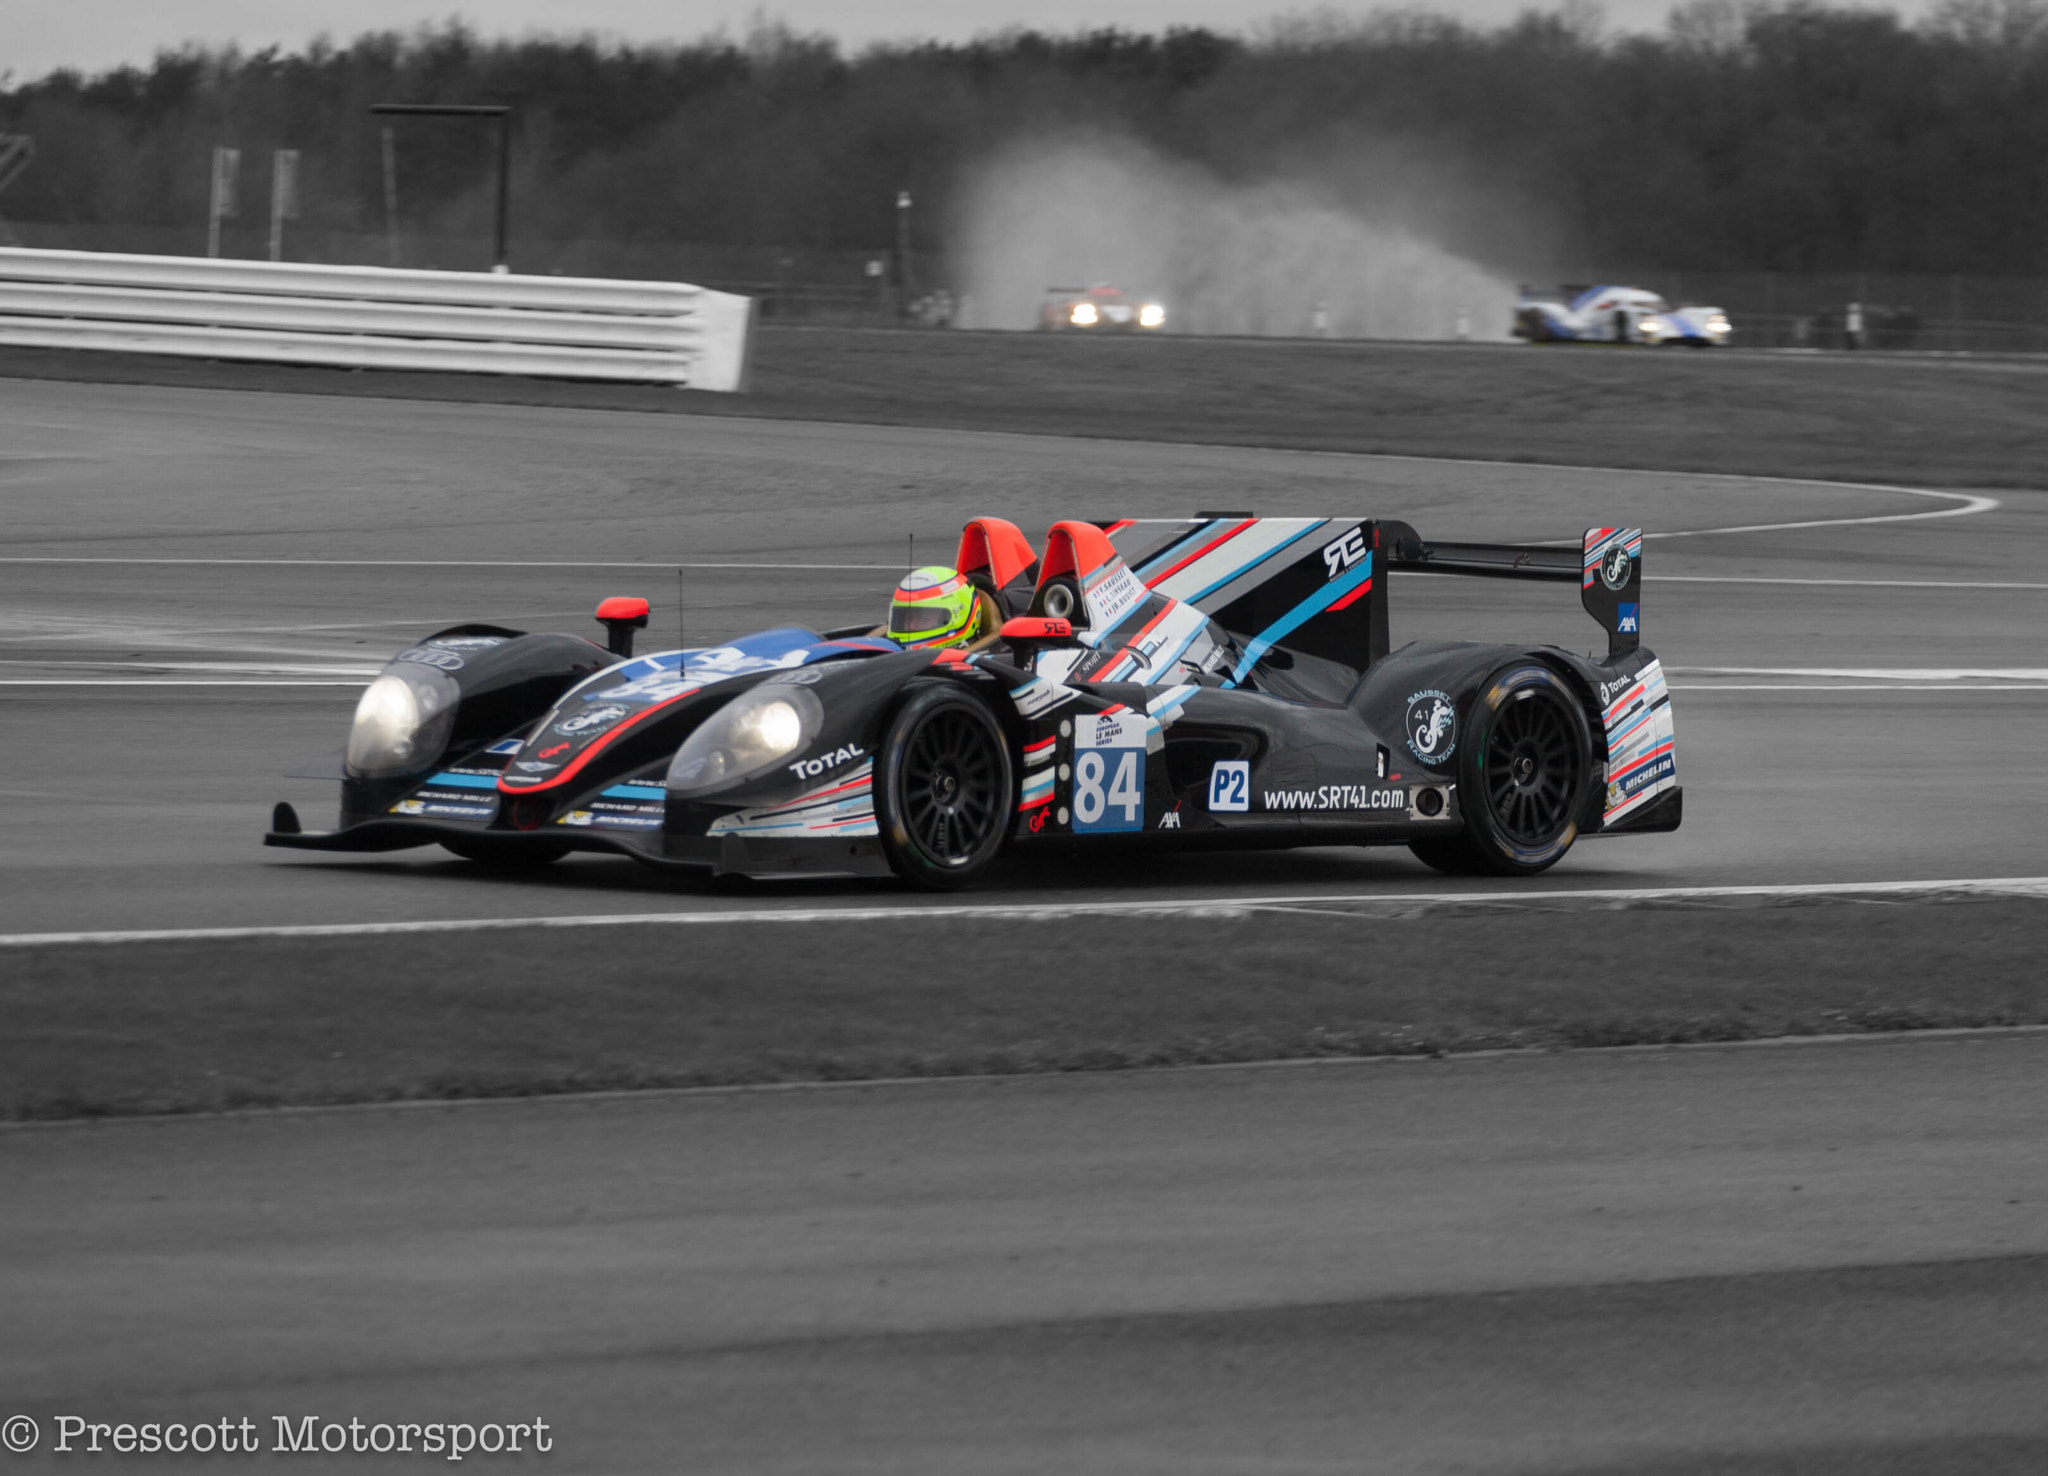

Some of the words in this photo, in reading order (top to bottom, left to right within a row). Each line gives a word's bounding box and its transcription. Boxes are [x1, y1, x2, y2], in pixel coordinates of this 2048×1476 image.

[1618, 616, 1638, 633] AXA
[1082, 649, 1102, 675] SPORT
[1407, 689, 1451, 705] SAUSSET
[1608, 674, 1631, 695] TOTAL
[1414, 709, 1429, 721] 41
[1096, 732, 1103, 740] LE
[1104, 727, 1123, 738] MANS
[788, 742, 865, 780] TOTAL
[1406, 739, 1437, 765] RACING
[1437, 743, 1456, 763] TEAM
[1213, 769, 1246, 804] P2
[1625, 758, 1672, 791] MICHELIN
[1074, 751, 1141, 824] 84
[1264, 785, 1404, 810] www.SRT41.com
[1158, 811, 1181, 829] AXA
